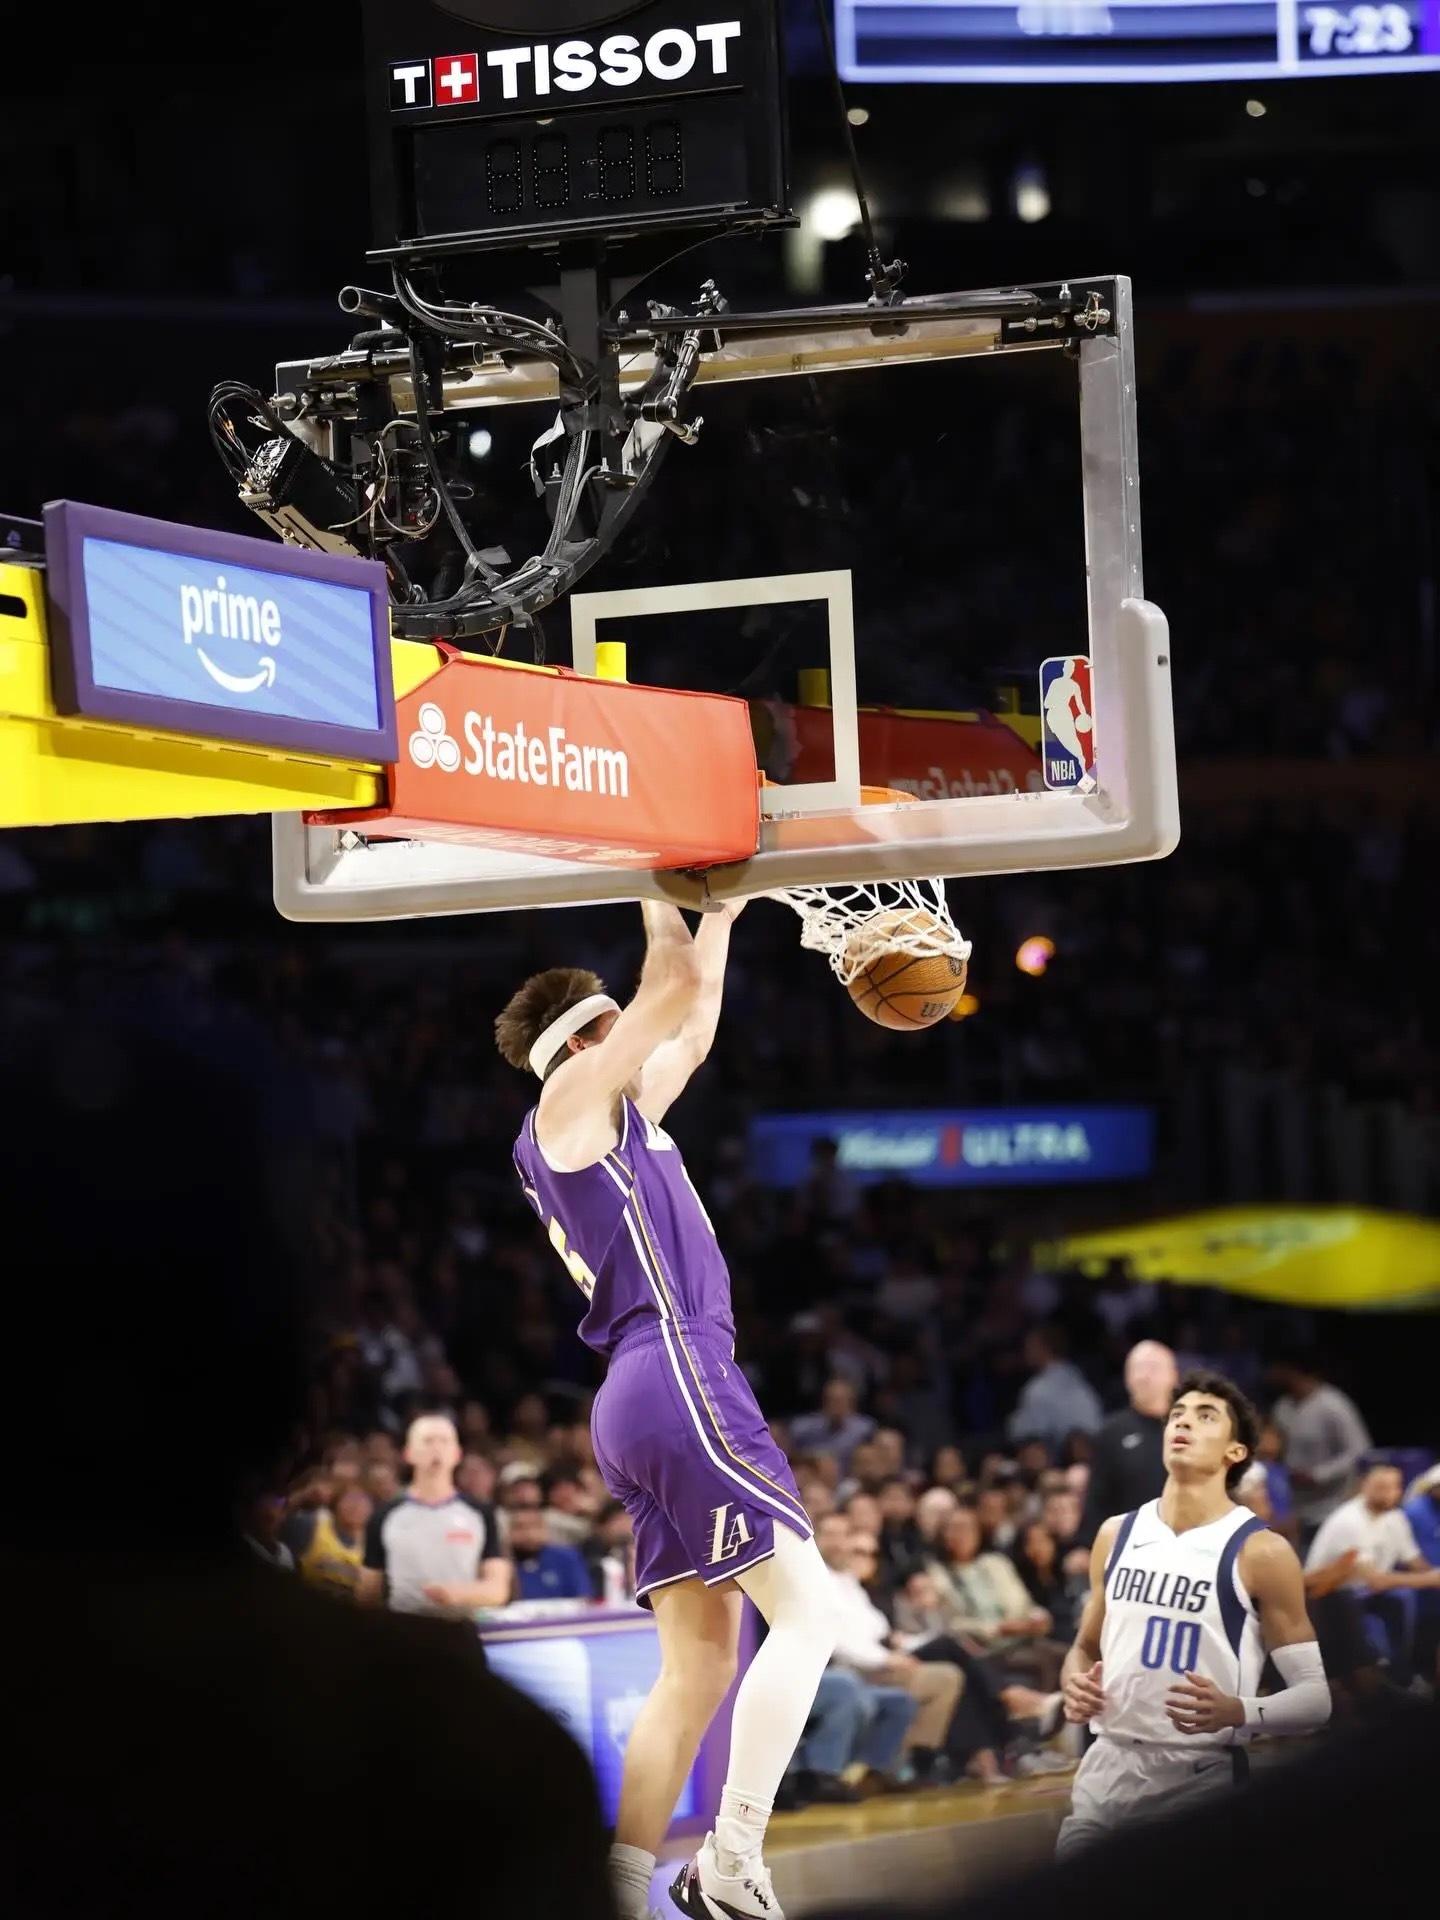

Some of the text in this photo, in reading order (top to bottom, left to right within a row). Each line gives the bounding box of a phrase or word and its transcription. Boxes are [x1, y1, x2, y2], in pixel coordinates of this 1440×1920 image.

[1306, 4, 1412, 55] 7:23
[487, 20, 742, 99] TISSOT
[180, 575, 282, 647] prime
[1051, 759, 1078, 783] NBA
[962, 1122, 1090, 1167] ULTRA
[703, 1502, 755, 1566] LA
[1112, 1567, 1212, 1614] DALLAS
[1140, 1615, 1202, 1675] 00
